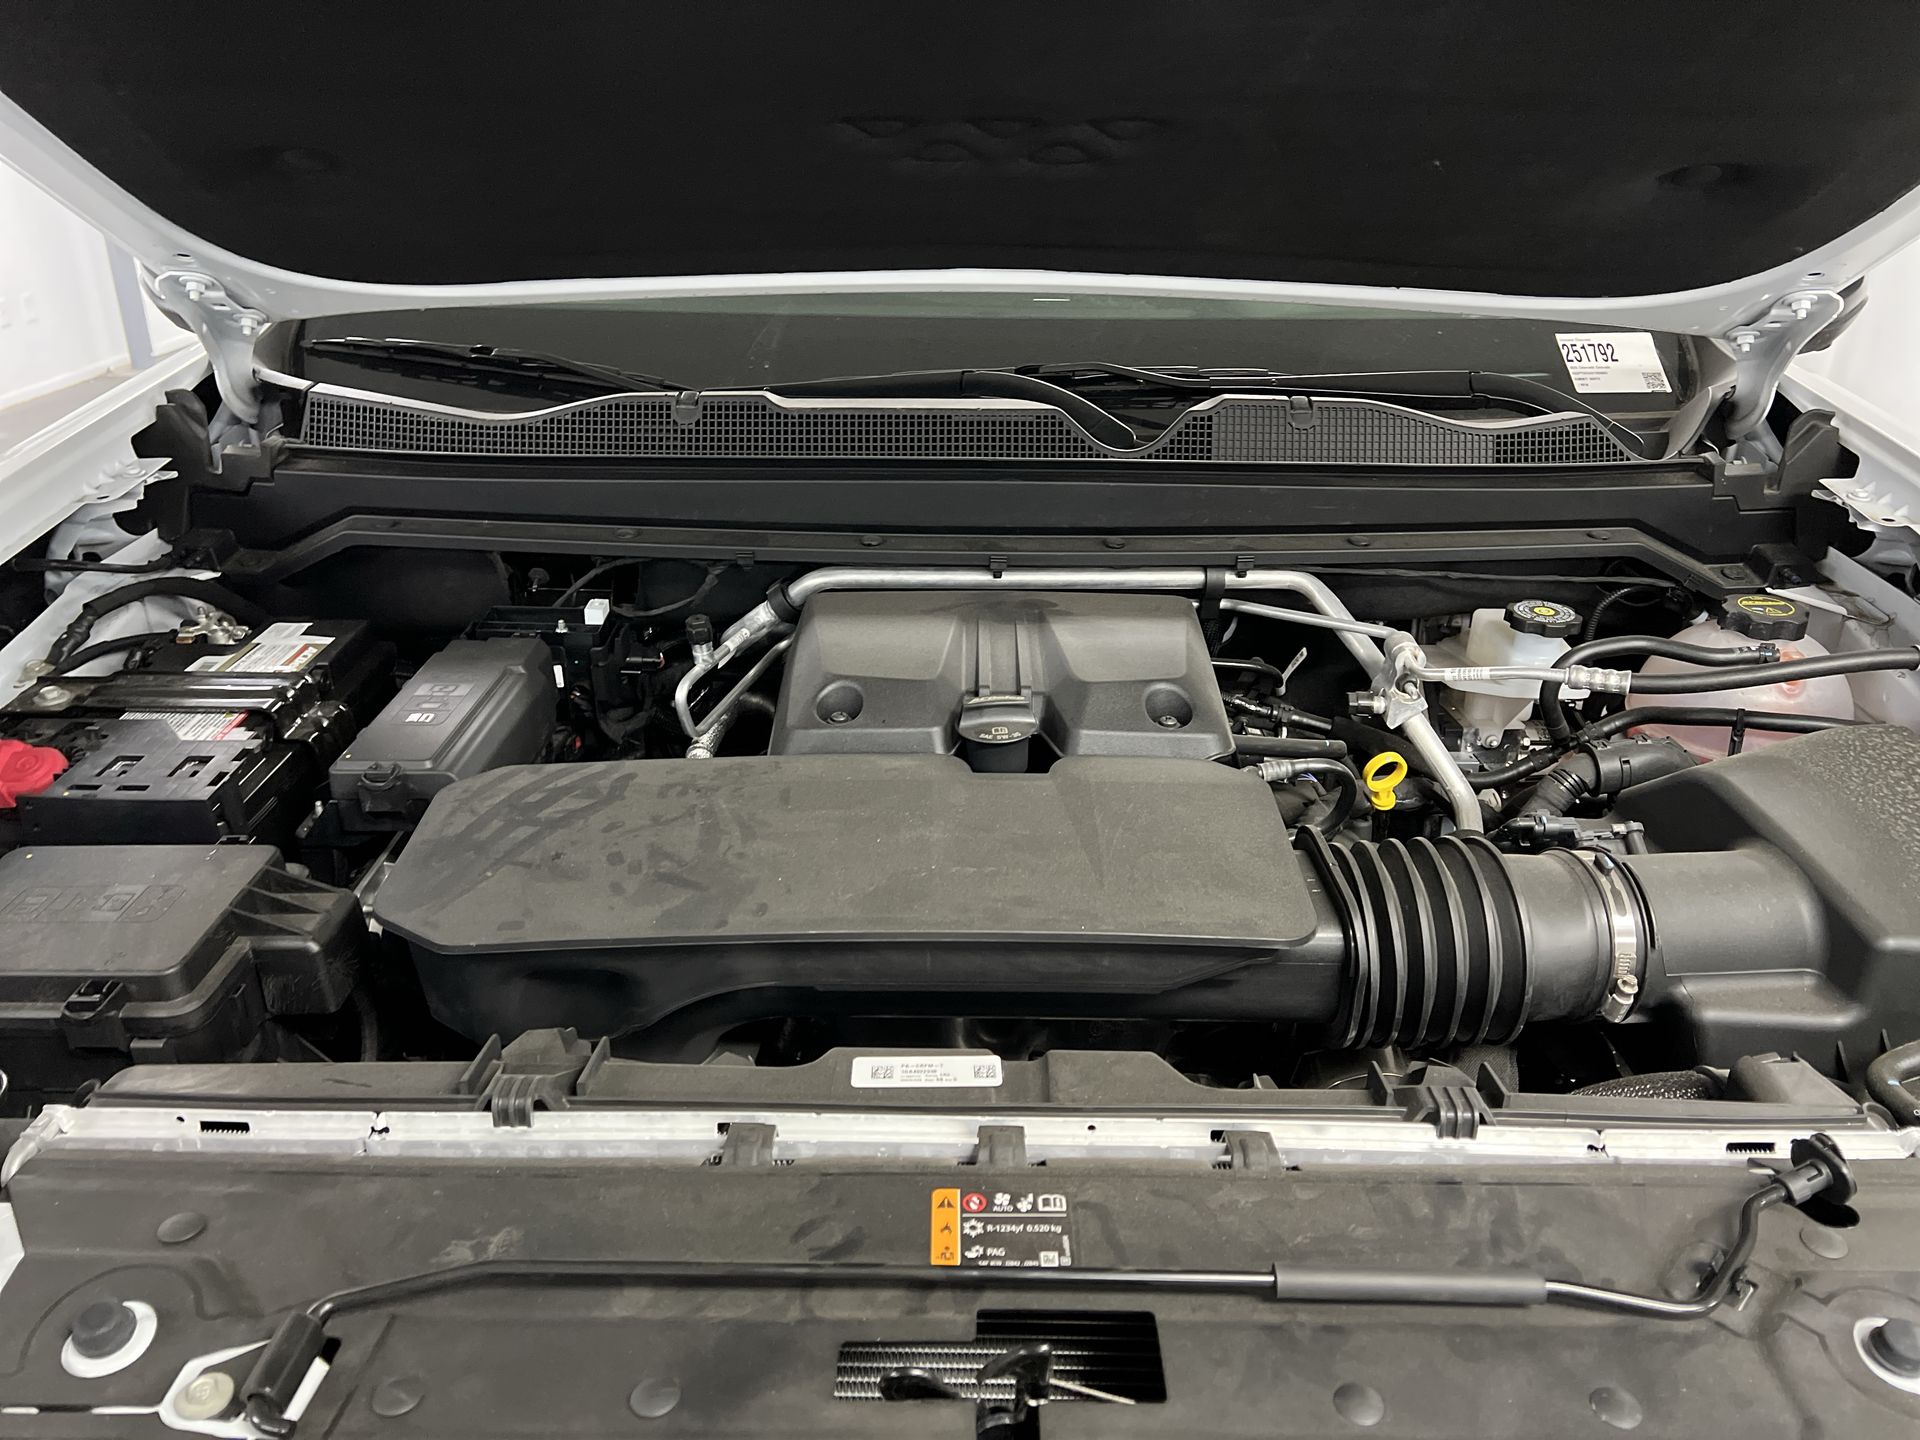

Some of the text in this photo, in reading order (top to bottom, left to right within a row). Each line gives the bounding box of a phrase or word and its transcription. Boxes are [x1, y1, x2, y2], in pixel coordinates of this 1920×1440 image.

[1561, 343, 1619, 363] 251792
[992, 1204, 1014, 1213] AUTO
[986, 1222, 1062, 1234] R-1234yf 0.520 kg
[986, 1246, 1007, 1257] PAG
